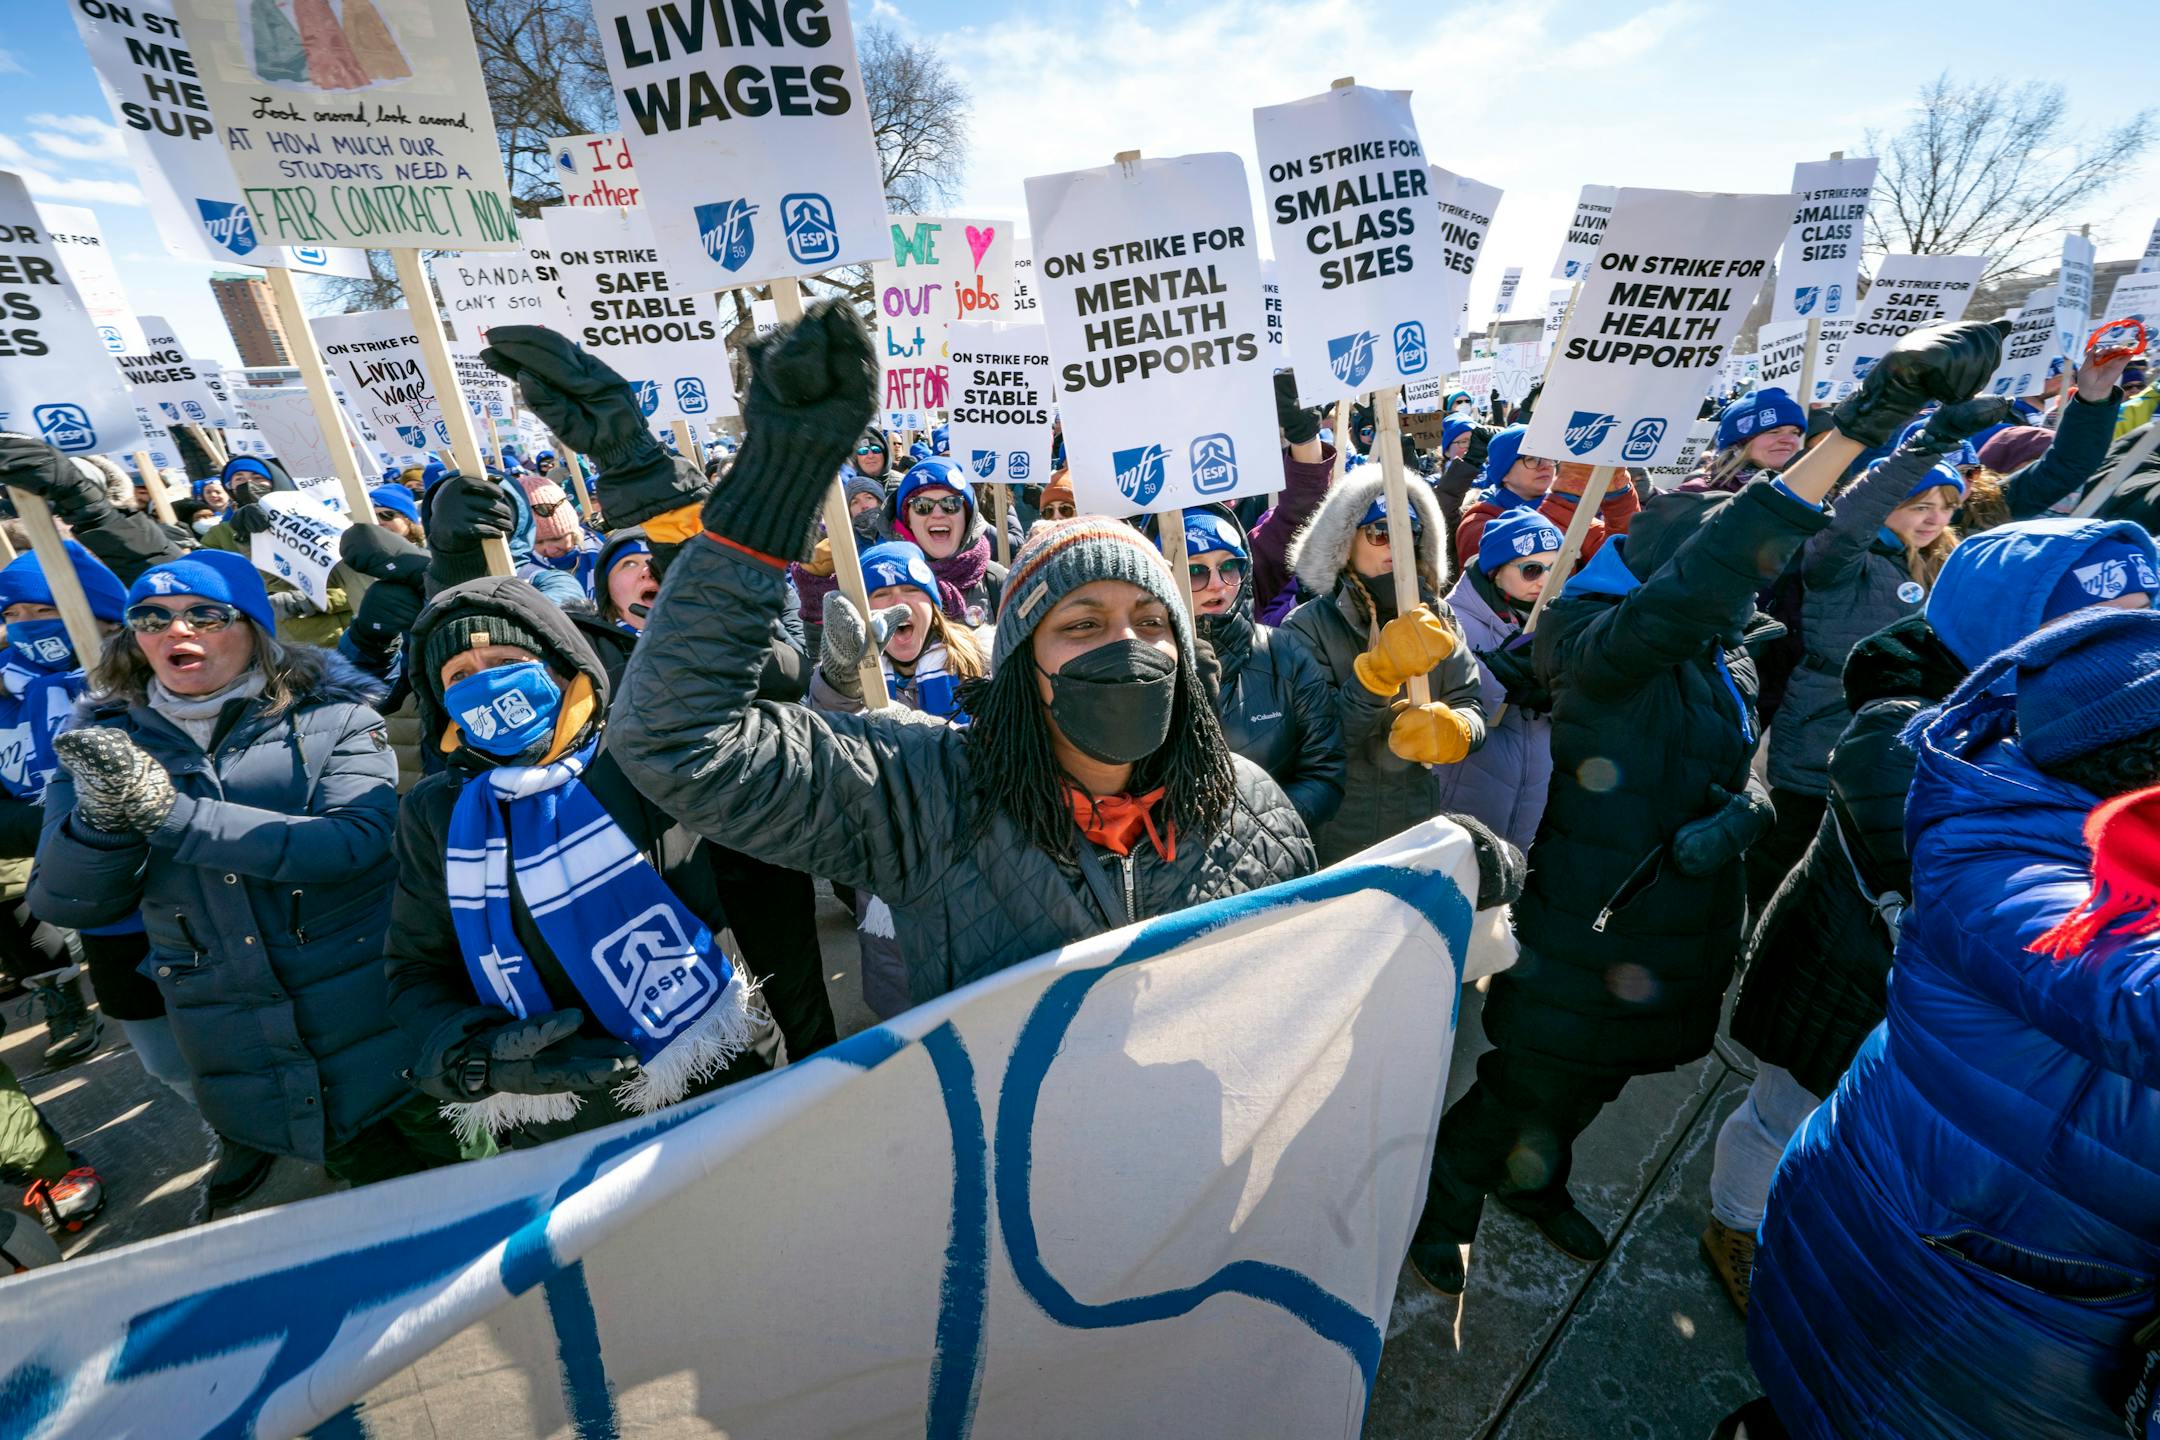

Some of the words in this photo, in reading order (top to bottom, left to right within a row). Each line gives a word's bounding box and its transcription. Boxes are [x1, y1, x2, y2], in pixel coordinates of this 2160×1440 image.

[79, 0, 136, 28] ON
[614, 0, 832, 69] LIVING
[125, 37, 200, 79] ME
[142, 74, 210, 112] HE
[623, 64, 852, 136] WAGES
[120, 102, 215, 141] SUP
[250, 96, 306, 121] Look
[375, 104, 409, 125] look
[227, 127, 253, 151] AT
[267, 131, 322, 156] HOW
[332, 135, 395, 157] MUCH
[400, 137, 445, 157] OUR
[587, 137, 634, 172] I'd
[1269, 159, 1304, 183] ON
[1309, 141, 1386, 175] STRIKE
[1389, 139, 1421, 158] FOR
[279, 160, 384, 182] STUDENTS
[395, 162, 449, 181] NEED
[456, 164, 473, 181] A
[568, 180, 641, 207] rather
[1274, 169, 1429, 225] SMALLER
[1814, 189, 1850, 201] STRIKE
[1850, 187, 1869, 198] FOR
[243, 186, 337, 242] FAIR
[332, 185, 464, 238] CONTRACT
[1470, 213, 1489, 227] FOR
[73, 235, 101, 247] FOR
[702, 197, 760, 267] mft
[799, 232, 827, 249] ESP
[1306, 207, 1415, 255] CLASS
[1568, 230, 1604, 246] WAG
[1801, 224, 1853, 243] CLASS
[531, 249, 550, 260] ON
[732, 245, 748, 259] 59
[891, 222, 943, 268] WE
[1044, 253, 1086, 279] ON
[1093, 234, 1187, 271] STRIKE
[1193, 226, 1245, 254] FOR
[1802, 244, 1847, 262] SIZES
[560, 251, 590, 266] ON
[593, 248, 658, 265] STRIKE
[1015, 259, 1032, 268] FOR
[1320, 244, 1414, 290] SIZES
[1600, 252, 1639, 272] ON
[1641, 256, 1725, 278] STRIKE
[1725, 259, 1766, 278] FOR
[458, 268, 533, 286] BANDA
[595, 271, 669, 295] SAFE
[1876, 279, 1896, 288] ON
[1897, 280, 1942, 290] STRIKE
[1942, 281, 1970, 290] FOR
[954, 274, 1000, 319] jobs
[1074, 264, 1228, 317] MENTAL
[1608, 282, 1732, 312] MENTAL
[1887, 293, 1941, 309] SAFE,
[456, 295, 495, 312] CAN'T
[590, 297, 696, 321] STABLE
[583, 320, 716, 347] SCHOOLS
[1084, 300, 1227, 353] HEALTH
[1599, 312, 1721, 341] HEALTH
[151, 336, 175, 346] FOR
[326, 344, 347, 356] ON
[350, 338, 400, 354] STRIKE
[887, 326, 925, 358] but
[1761, 342, 1774, 350] ON
[2011, 330, 2052, 347] CLASS
[117, 350, 184, 368] LIVING
[952, 353, 973, 364] ON
[976, 353, 1020, 365] STRIKE
[1023, 354, 1049, 366] FOR
[1062, 333, 1259, 393] SUPPORTS
[1332, 330, 1380, 382] mft
[1404, 349, 1421, 361] ESP
[1565, 338, 1724, 368] SUPPORTS
[2007, 345, 2044, 360] SIZES
[125, 366, 197, 384] WAGES
[349, 357, 425, 389] Living
[458, 370, 498, 379] HEALTH
[973, 370, 1029, 389] SAFE,
[964, 389, 1038, 406] STABLE
[1408, 381, 1439, 393] LIVING
[1408, 390, 1440, 401] WAGES
[953, 408, 1048, 425] SCHOOLS
[1565, 411, 1621, 453] mft
[1583, 441, 1594, 450] 59
[1632, 442, 1652, 452] ESP
[1117, 443, 1173, 500] mft
[1203, 466, 1226, 482] ESP
[1144, 483, 1157, 495] 59
[268, 509, 336, 552] STABLE
[1256, 712, 1282, 721] Columbia
[644, 965, 688, 1001] esp
